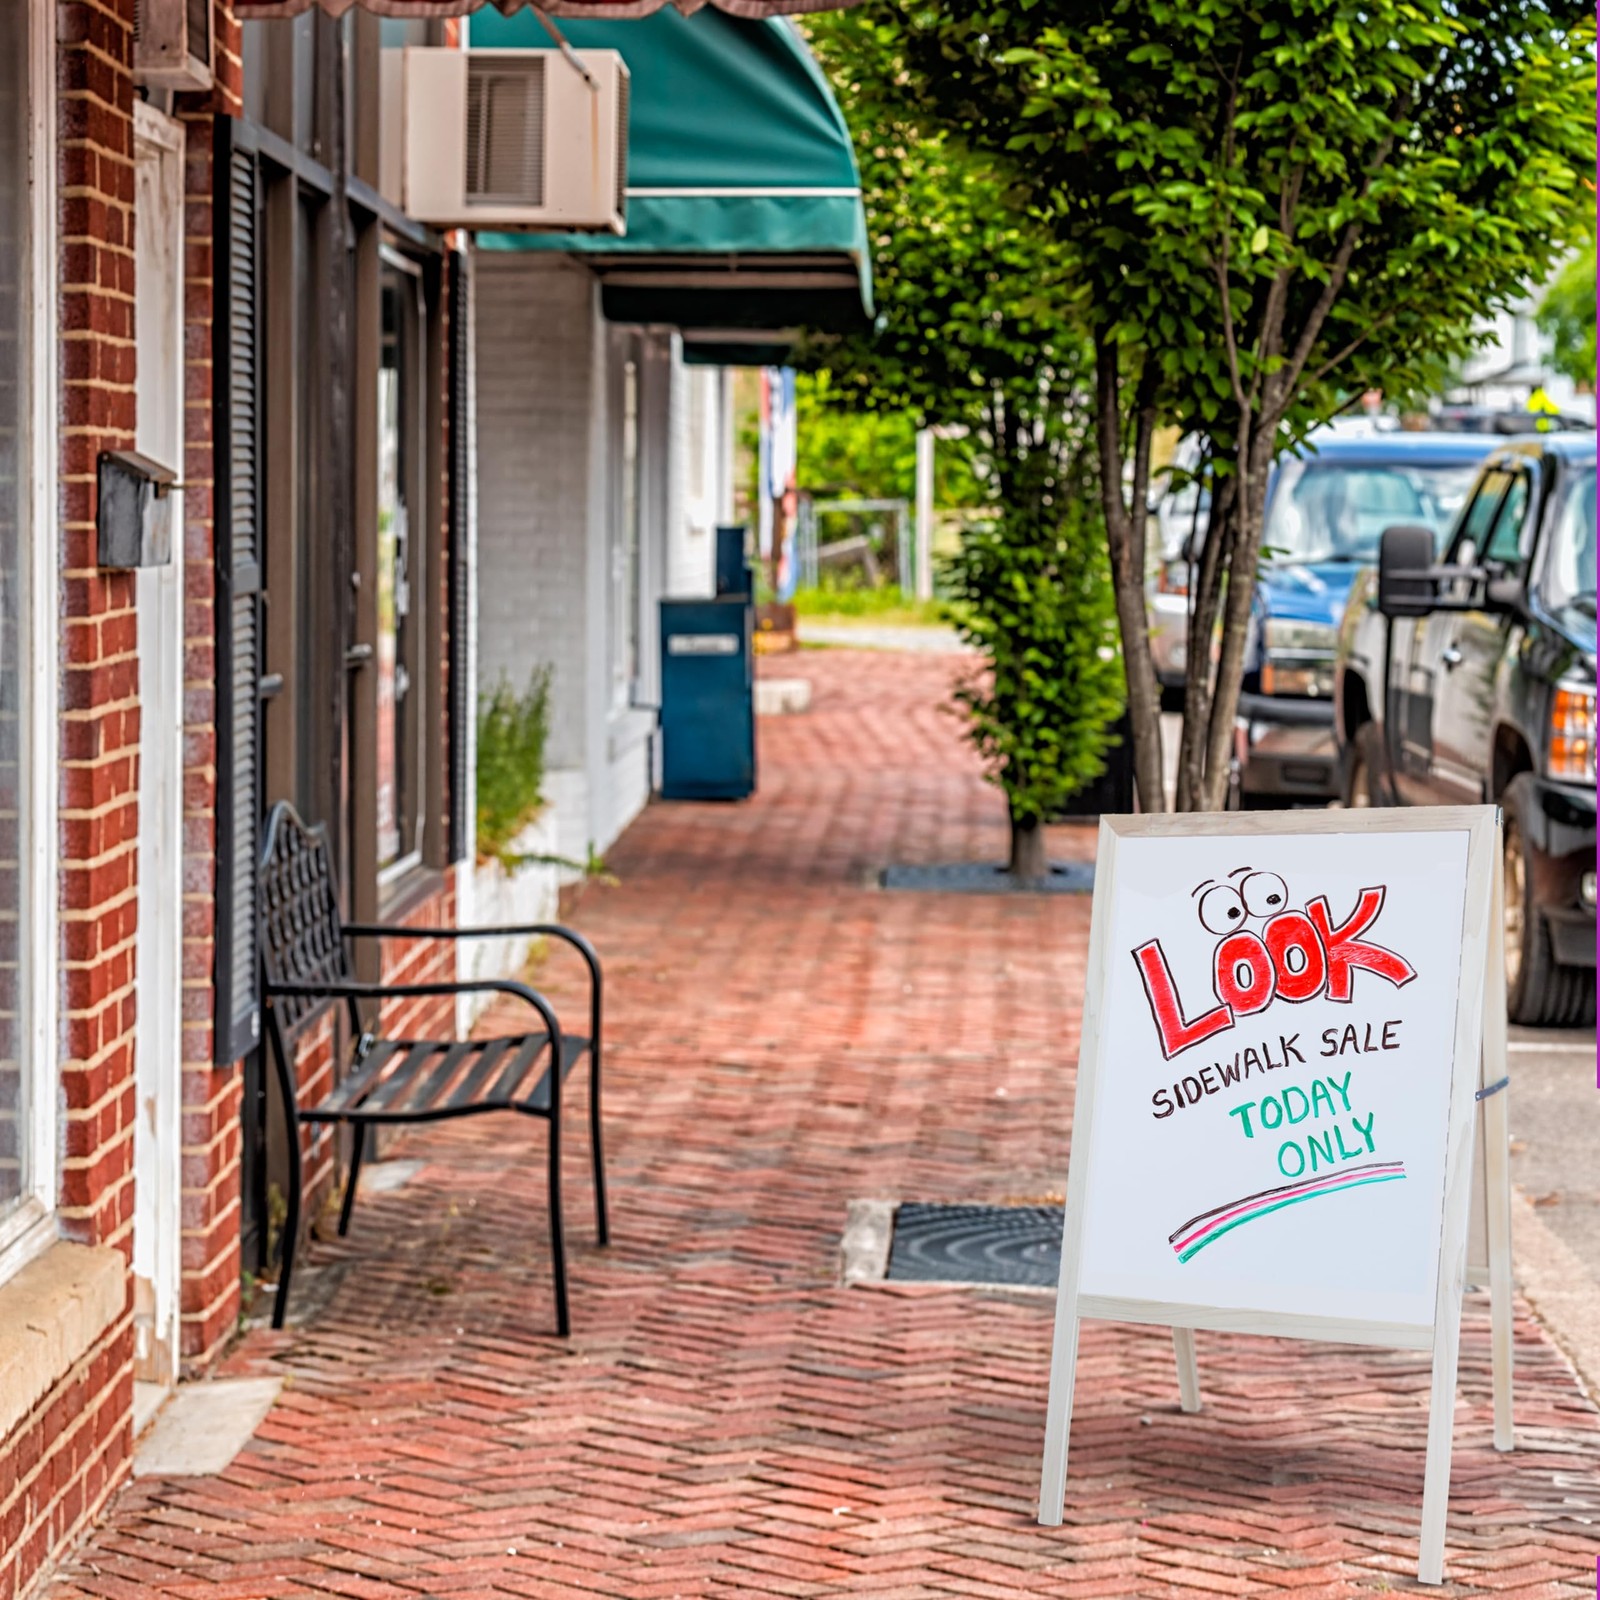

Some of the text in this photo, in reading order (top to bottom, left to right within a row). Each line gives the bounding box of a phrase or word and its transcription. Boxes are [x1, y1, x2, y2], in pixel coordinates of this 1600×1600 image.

[1131, 885, 1418, 1060] LOOK
[1152, 1020, 1403, 1119] SIDEWALK SALE
[1229, 1071, 1352, 1138] TODAY
[1278, 1112, 1375, 1178] ONLY
